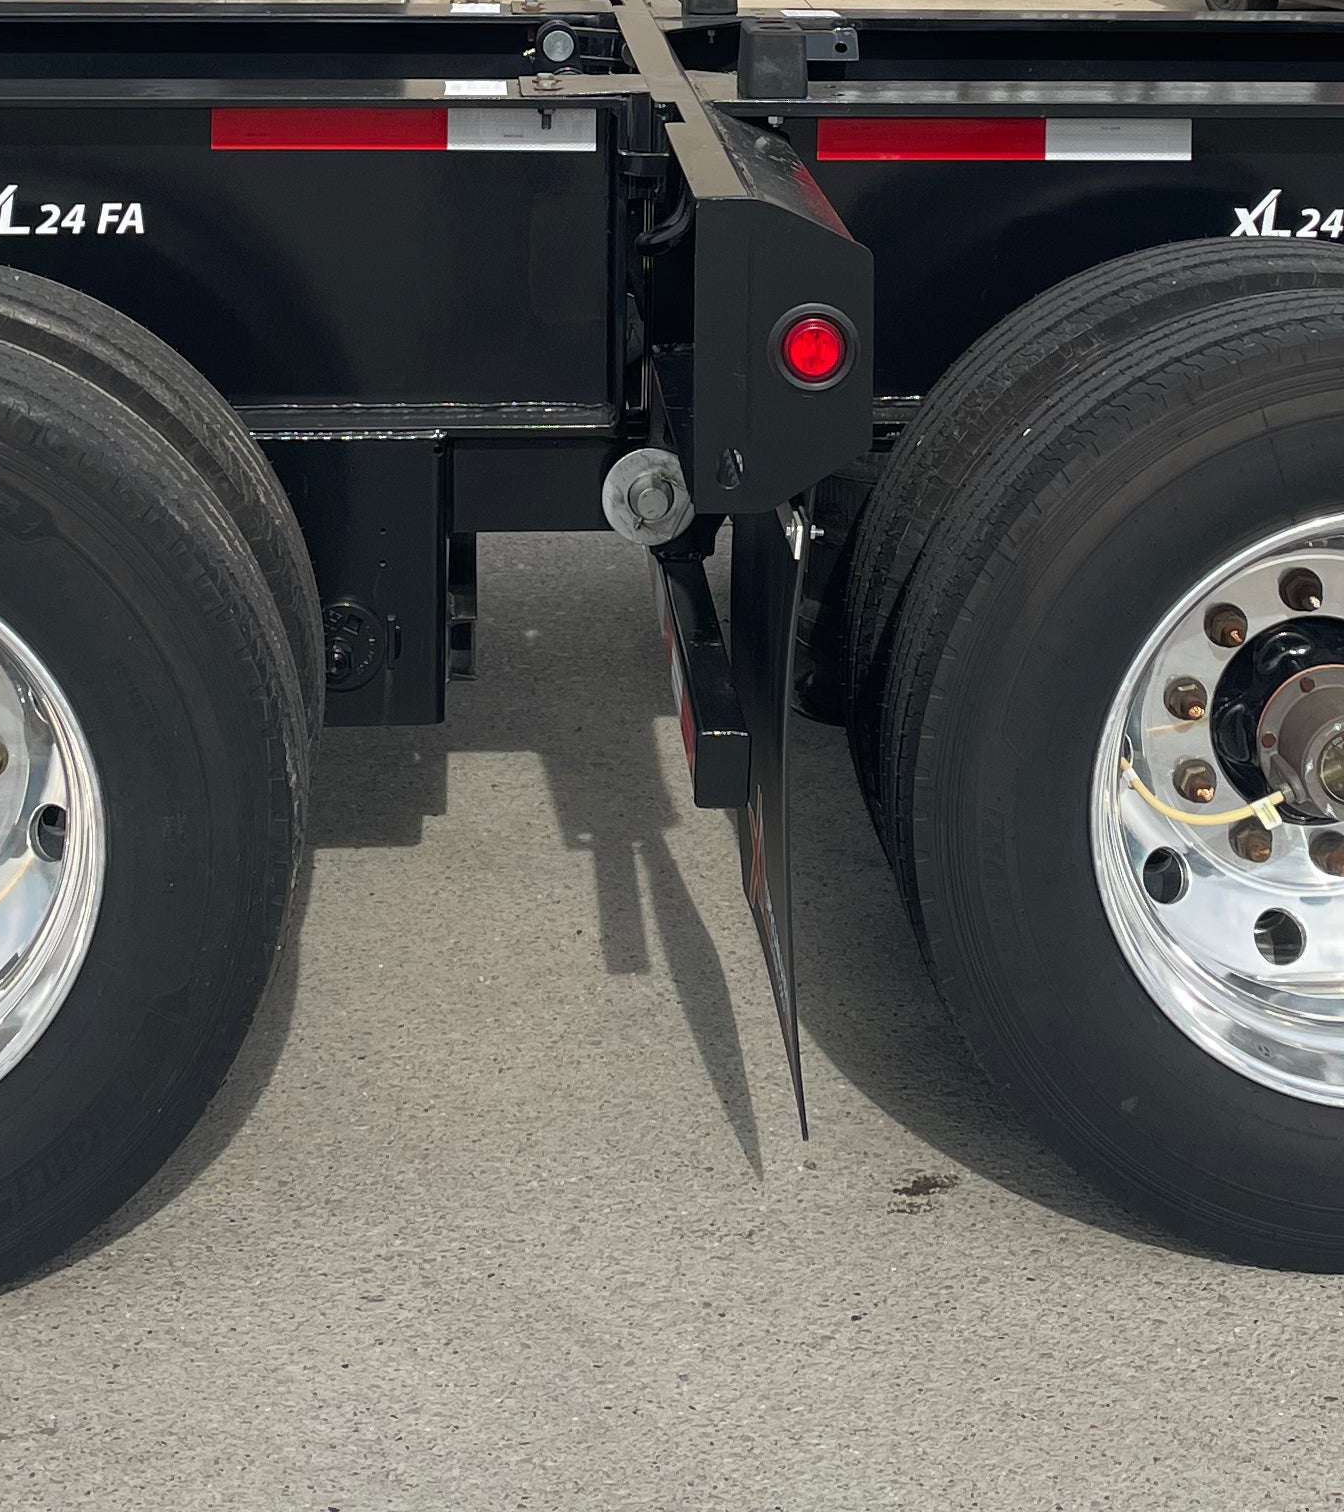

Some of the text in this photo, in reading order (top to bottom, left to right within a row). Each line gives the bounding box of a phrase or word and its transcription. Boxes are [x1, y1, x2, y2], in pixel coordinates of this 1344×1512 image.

[35, 203, 86, 235] 24
[97, 202, 145, 234] FA
[1229, 189, 1291, 237] XL
[1296, 208, 1344, 238] 24
